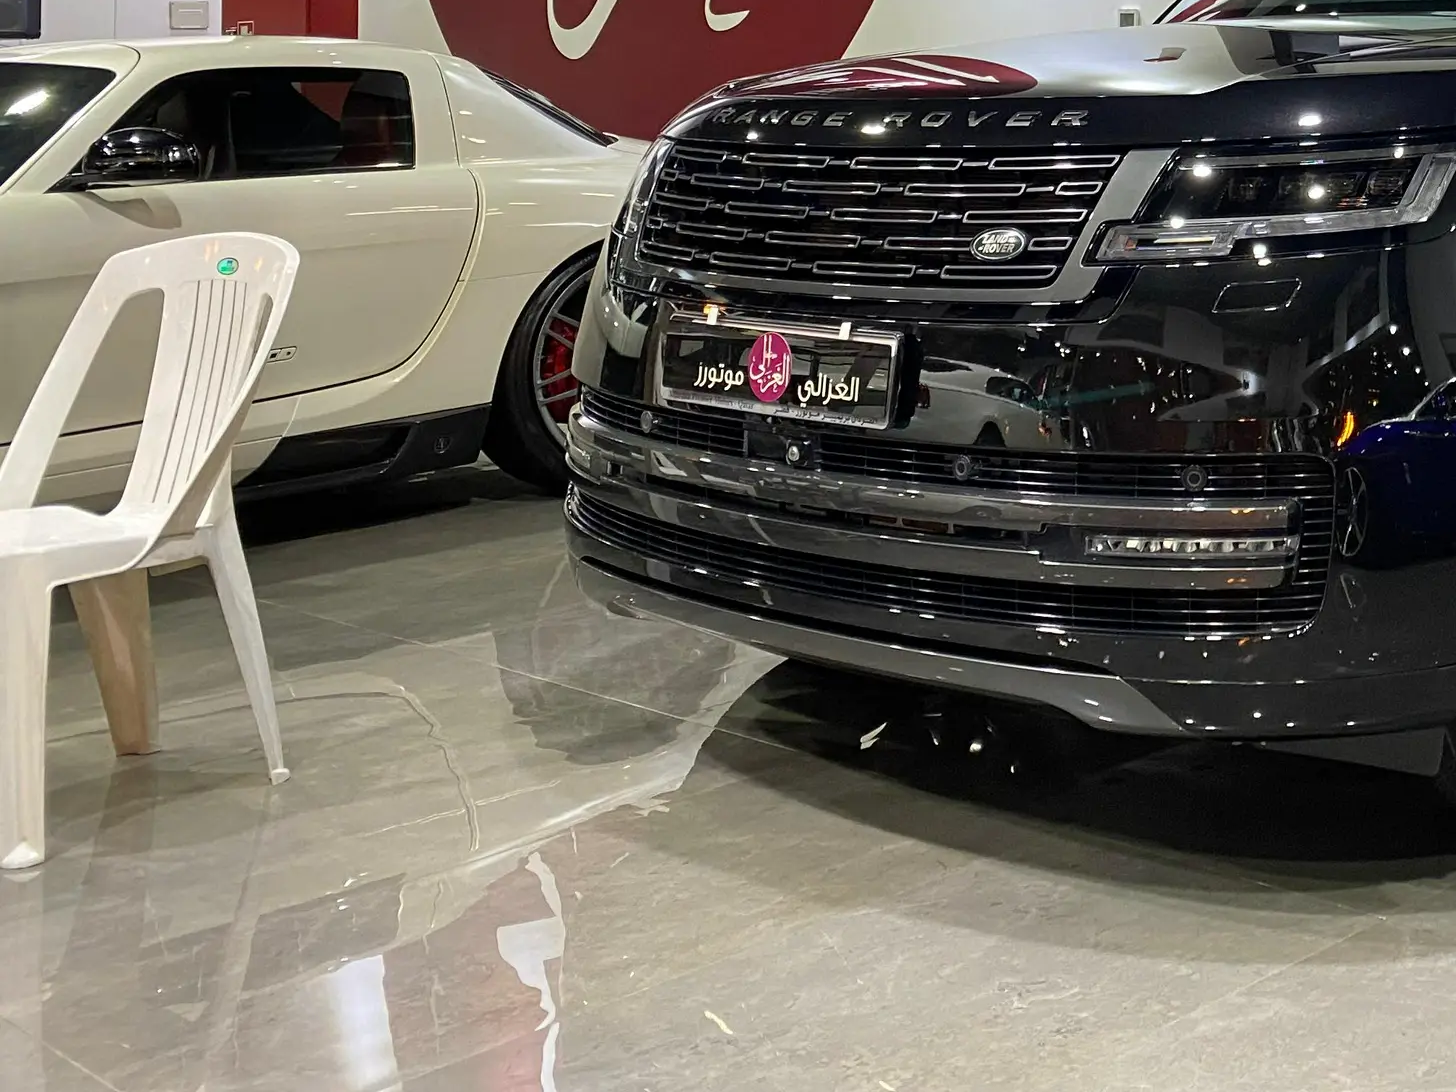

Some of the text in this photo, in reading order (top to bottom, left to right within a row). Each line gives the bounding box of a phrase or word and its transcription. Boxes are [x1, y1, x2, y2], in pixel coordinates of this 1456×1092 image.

[712, 106, 1089, 128] RANGE ROVER
[982, 234, 1010, 244] LAND
[982, 243, 1015, 254] ROVER
[693, 361, 861, 408] الغزالي موتورز
